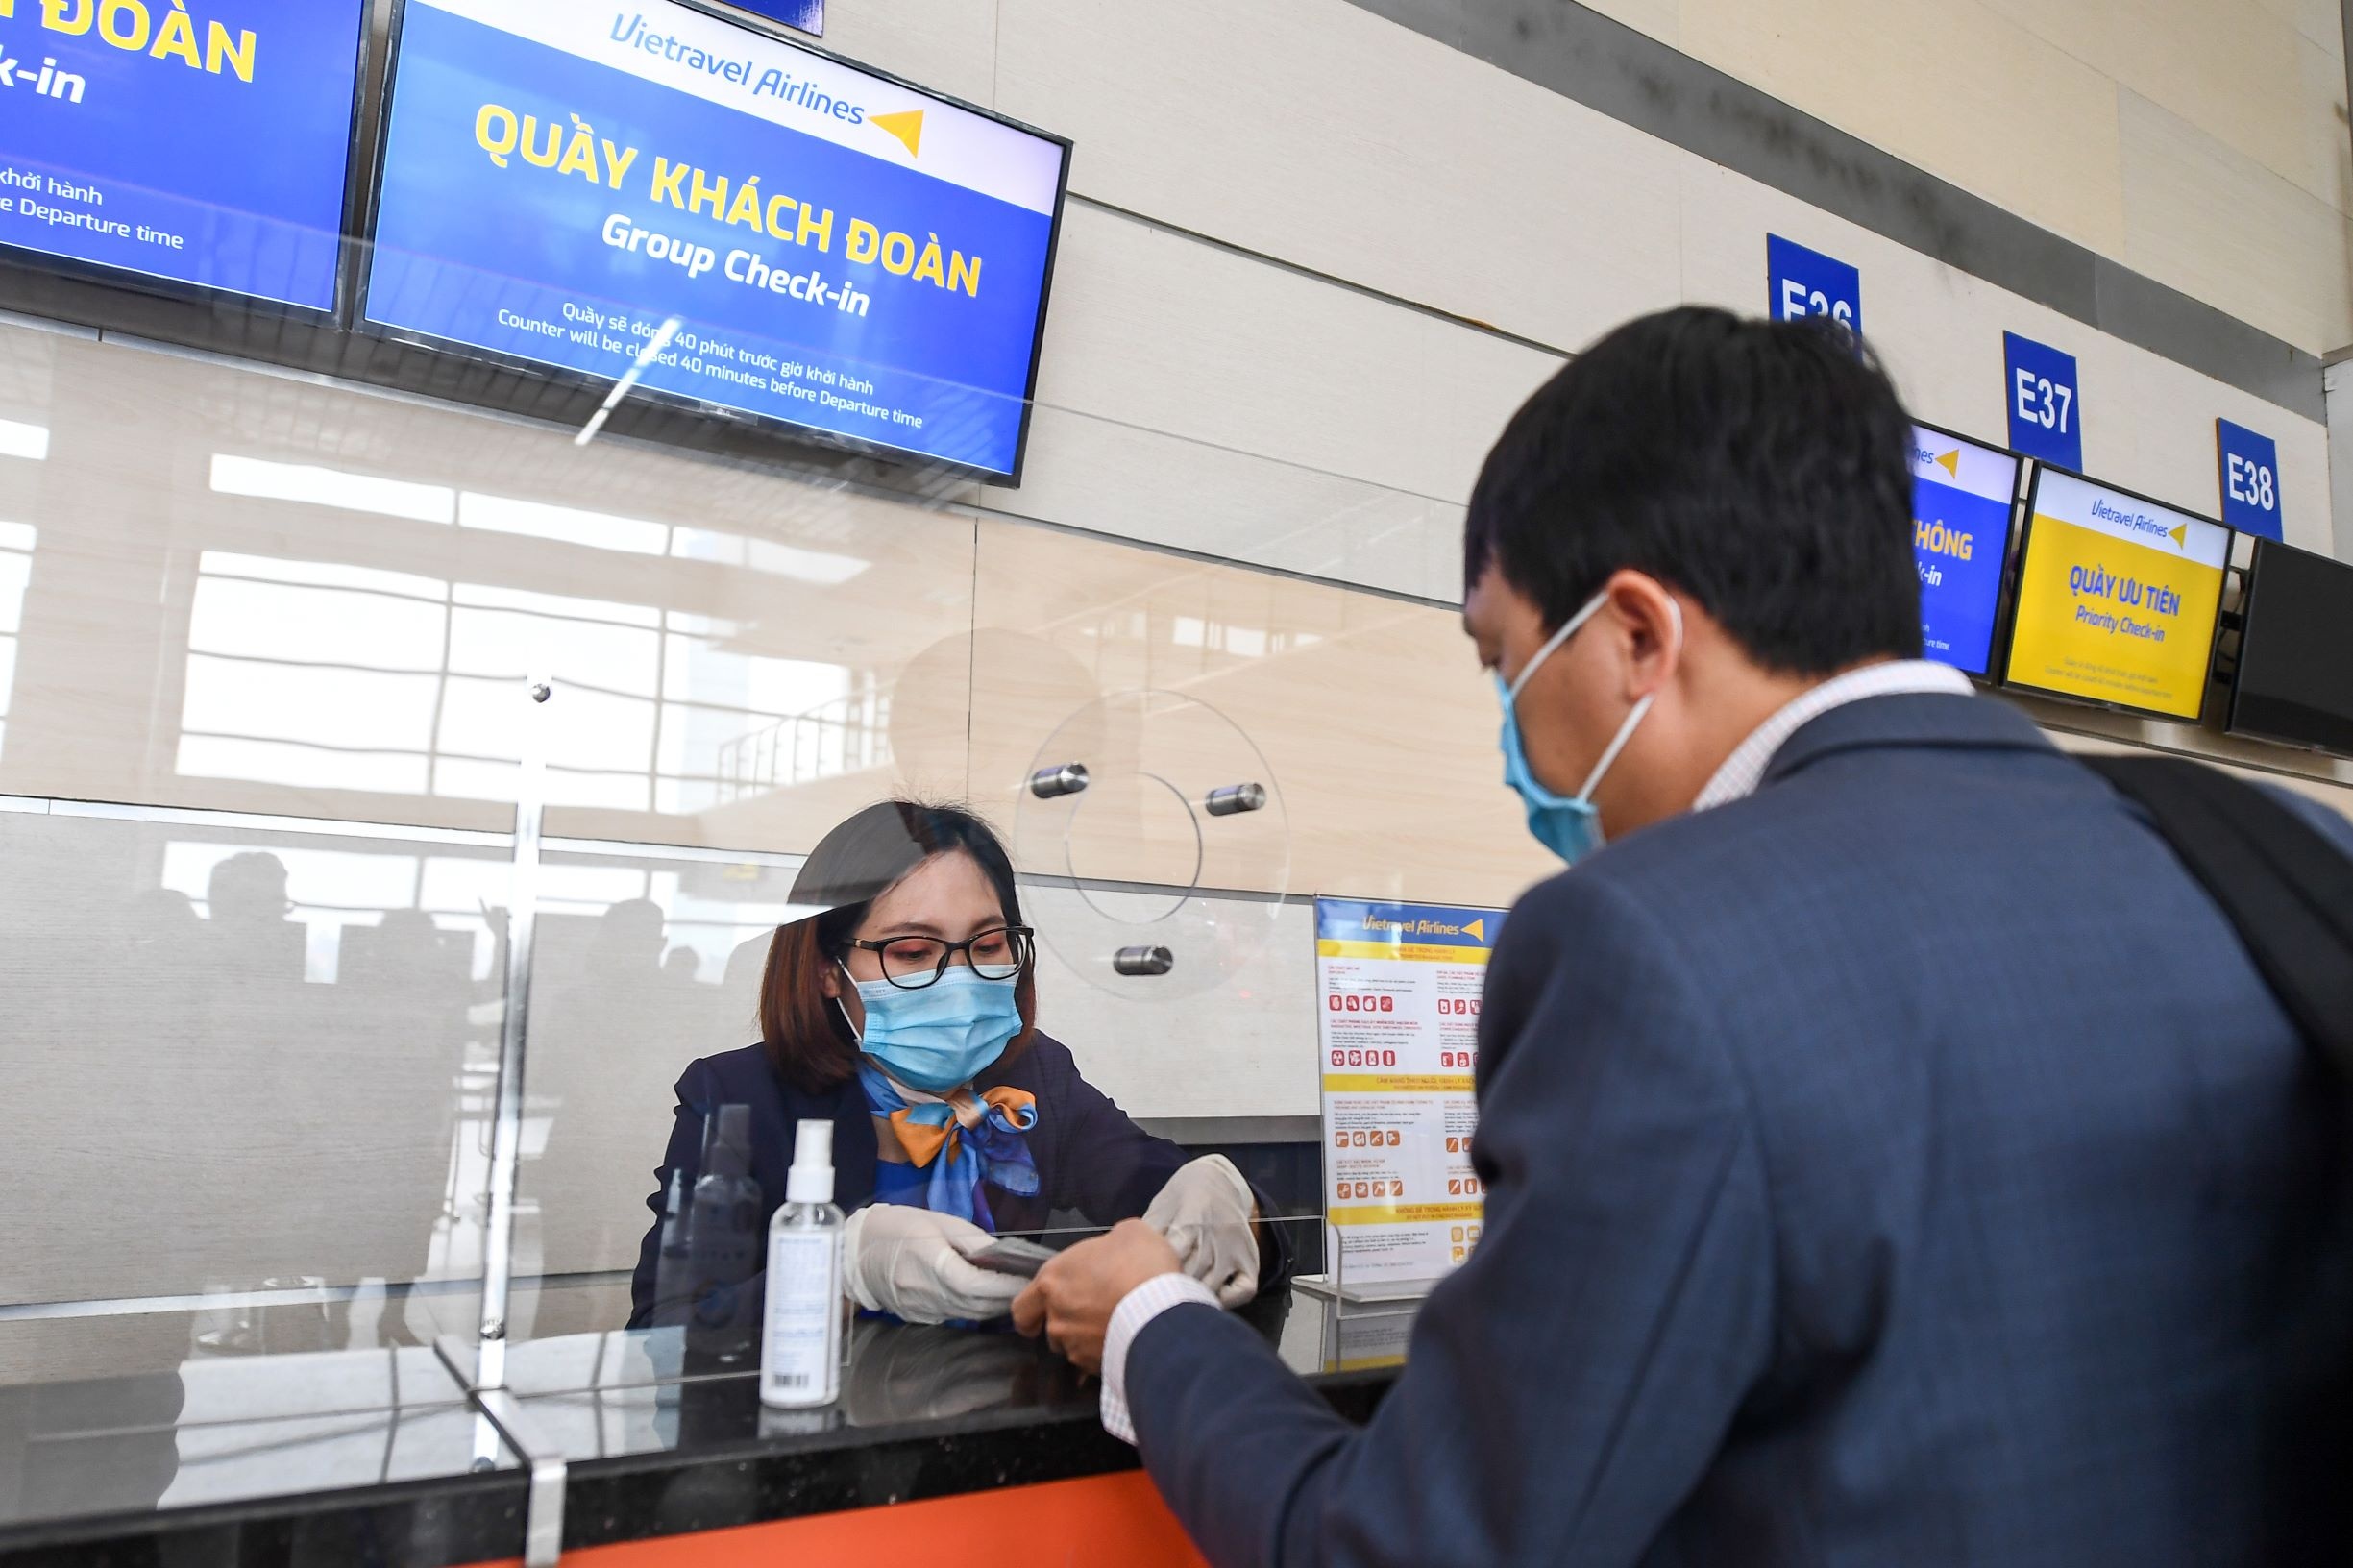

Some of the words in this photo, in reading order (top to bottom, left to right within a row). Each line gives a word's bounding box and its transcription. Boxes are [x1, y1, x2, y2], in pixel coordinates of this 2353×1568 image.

[39, 0, 257, 83] ĐOÀN
[609, 13, 752, 86] Vietravel
[752, 68, 865, 125] Airlines
[48, 177, 103, 206] hành
[475, 104, 639, 190] QUẦY
[650, 156, 834, 253] KHÁCH
[846, 217, 982, 298] ĐOÀN
[19, 197, 131, 238] Departure
[136, 225, 184, 250] time
[601, 213, 716, 279] Group
[724, 249, 870, 317] Check-in
[498, 308, 566, 339] Counter
[570, 330, 598, 349] will
[602, 334, 622, 354] be
[680, 355, 702, 374] 40
[705, 363, 767, 390] minutes
[770, 378, 817, 402] before
[819, 389, 890, 420] Departure
[892, 409, 923, 429] time
[562, 302, 605, 330] Quầy
[608, 315, 627, 332] sẽ
[674, 331, 697, 350] 40
[699, 339, 734, 360] phút
[739, 348, 777, 372] trước
[780, 360, 804, 378] giờ
[806, 365, 836, 386] khởi
[839, 376, 874, 396] hành
[2016, 367, 2071, 434] E37
[2227, 453, 2275, 511] E38
[1912, 518, 1973, 561] HÔNG
[2091, 499, 2134, 527] Vietravel
[2133, 515, 2169, 538] Airlines
[2069, 563, 2117, 599] QUẦY
[2119, 577, 2144, 606] ƯU
[2145, 584, 2181, 617] TIÊN
[2075, 605, 2119, 635] Priority
[2120, 616, 2166, 642] Check-in
[1362, 914, 1415, 932] Vietrvel
[1416, 919, 1459, 936] Airlines
